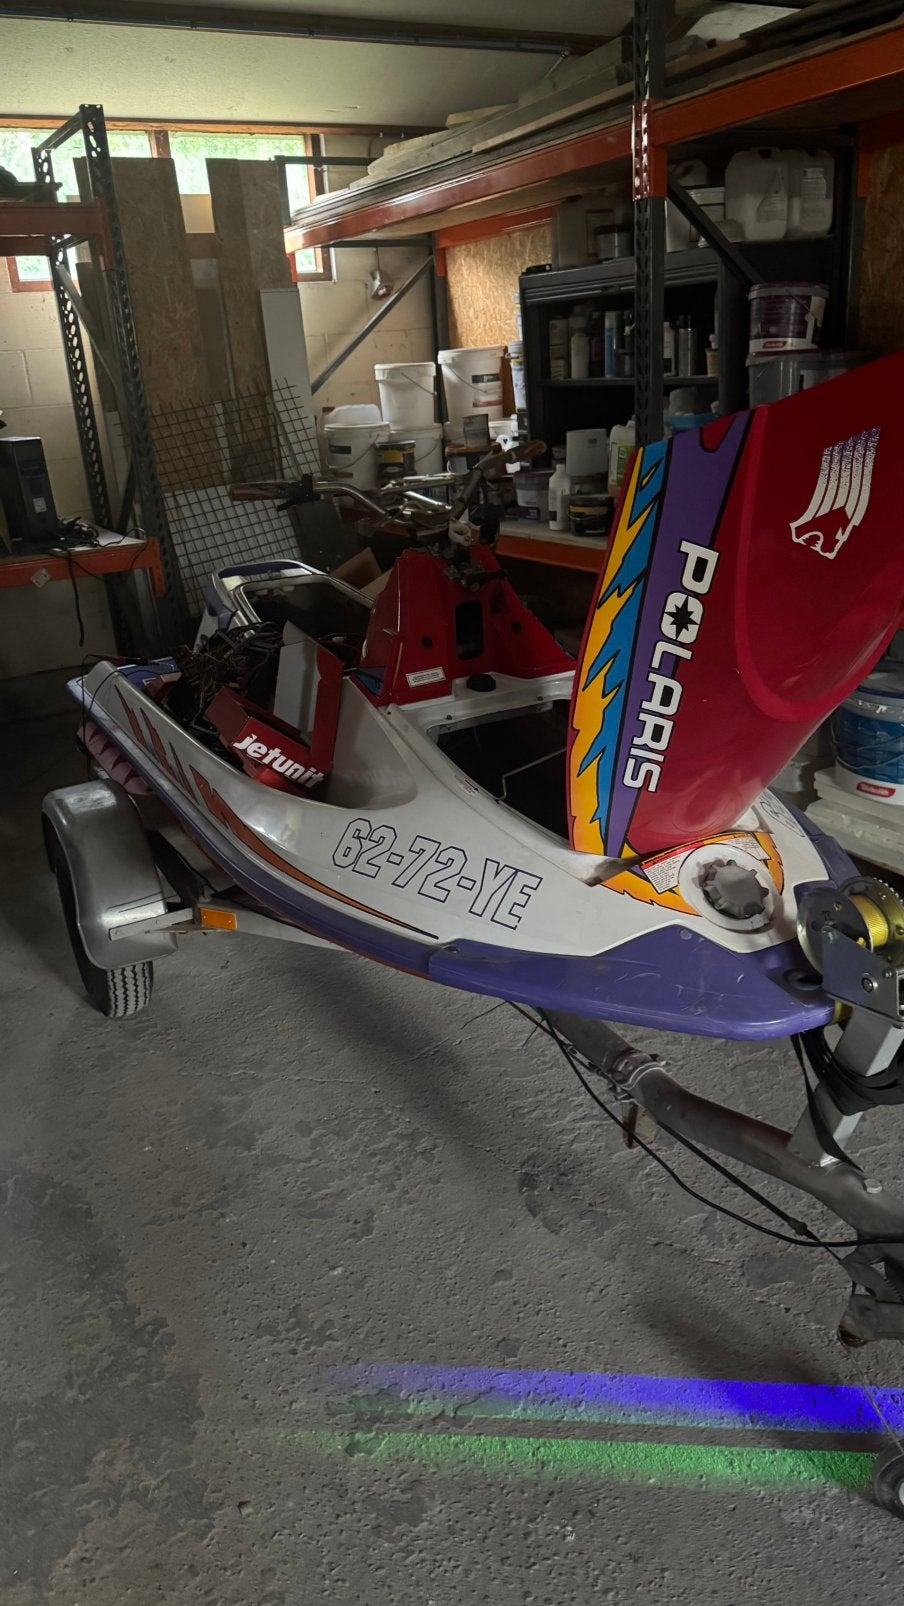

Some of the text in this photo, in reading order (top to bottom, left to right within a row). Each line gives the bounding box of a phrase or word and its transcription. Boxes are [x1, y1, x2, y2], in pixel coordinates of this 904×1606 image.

[621, 540, 719, 792] POLARIS
[232, 733, 325, 788] jetunit
[332, 817, 543, 930] 62-72-YE
